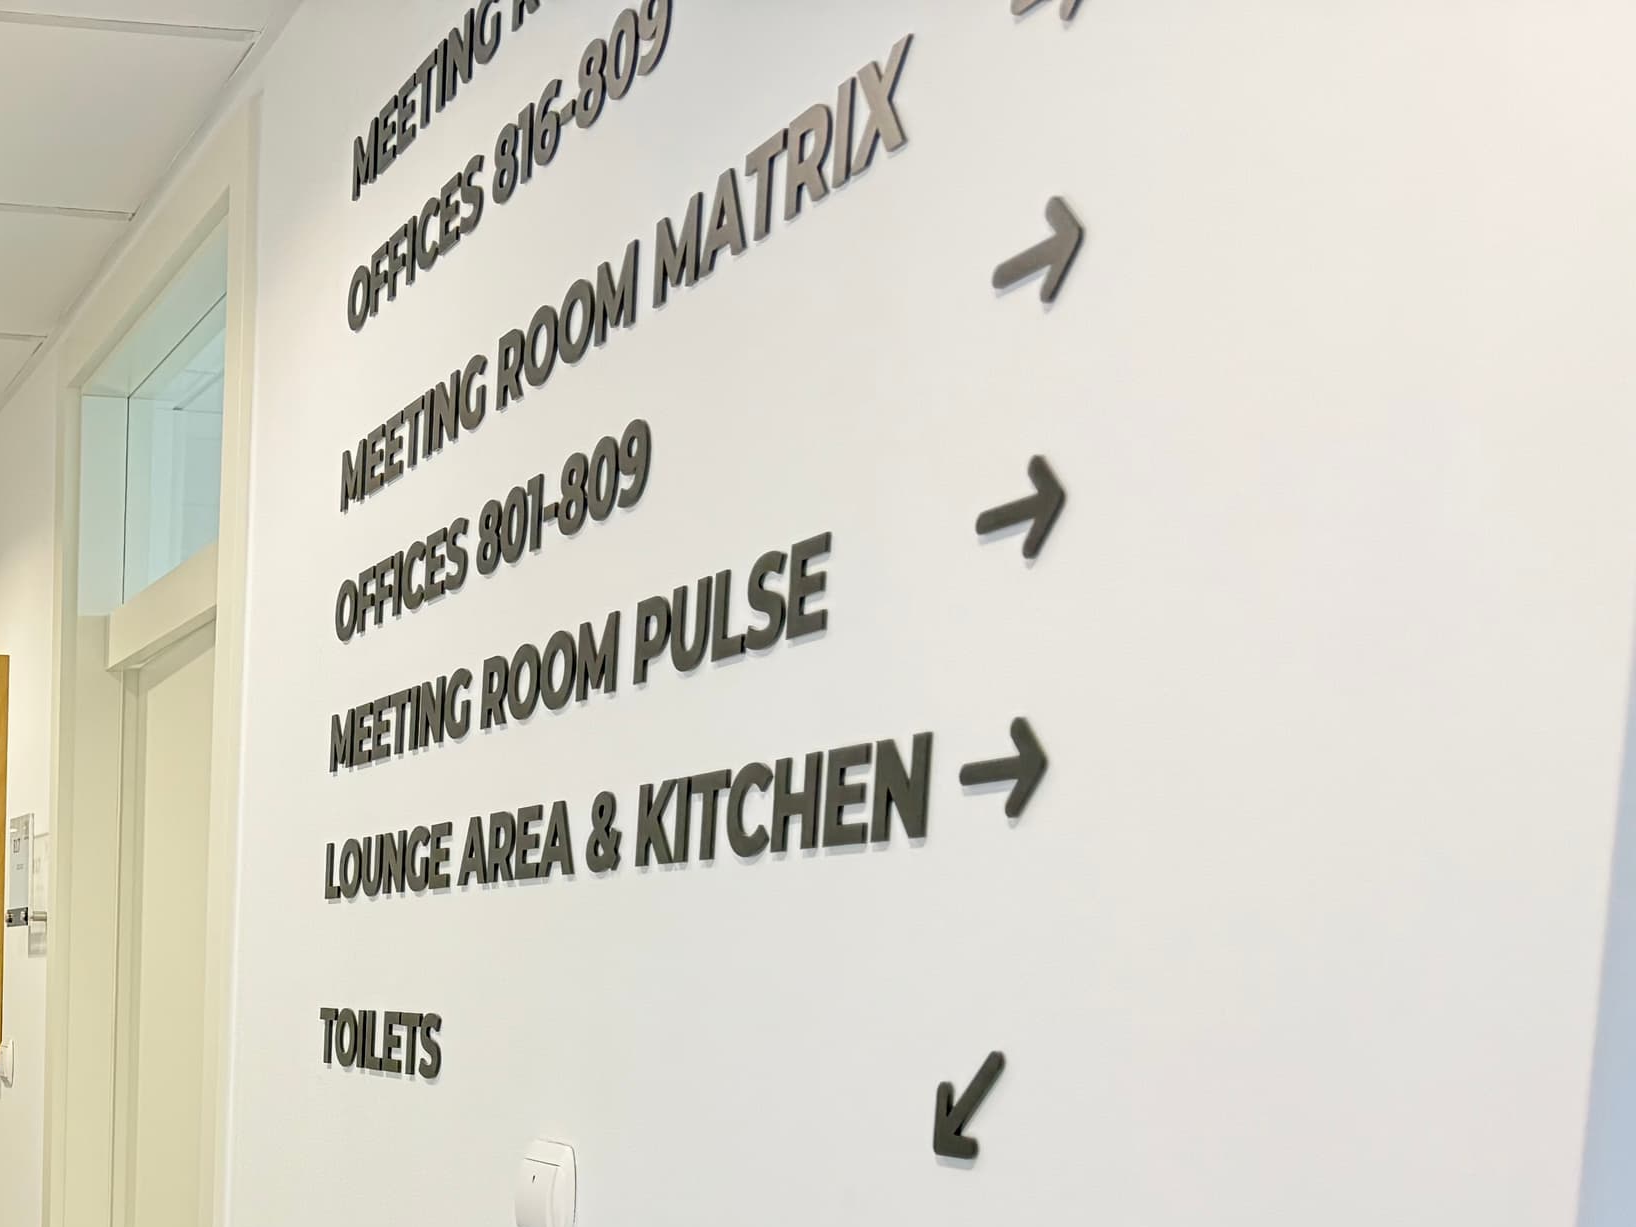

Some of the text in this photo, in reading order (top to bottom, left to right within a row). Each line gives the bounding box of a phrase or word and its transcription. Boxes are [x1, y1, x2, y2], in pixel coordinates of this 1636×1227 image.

[348, 0, 673, 332] OFFICES 816-809
[352, 0, 502, 201] MEETING
[340, 34, 914, 514] MEETING ROOM MATRIX
[335, 419, 652, 641] OFFICES 801-809
[330, 532, 832, 772] MEETING ROOM PULSE
[325, 732, 933, 899] LOUNGE AREA & KITCHEN
[320, 1008, 442, 1079] TOILETS
